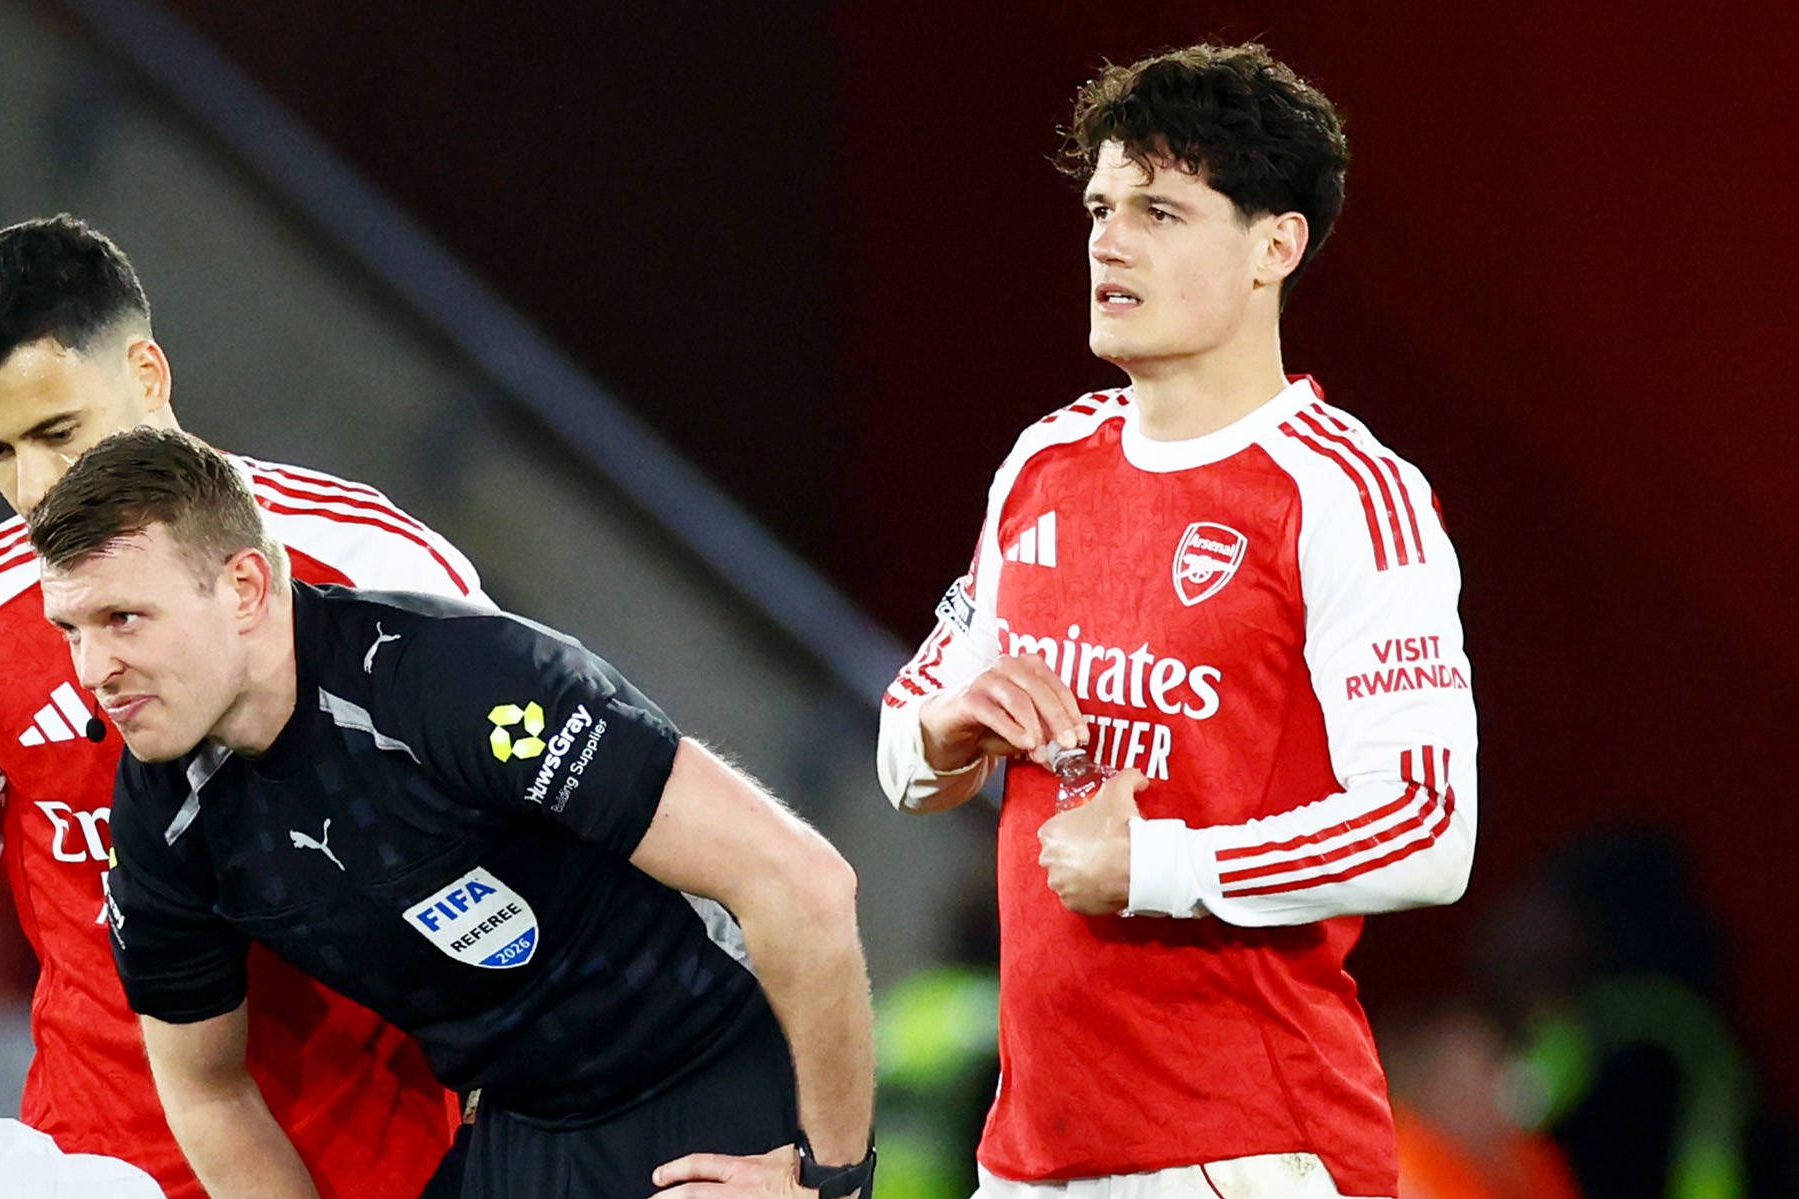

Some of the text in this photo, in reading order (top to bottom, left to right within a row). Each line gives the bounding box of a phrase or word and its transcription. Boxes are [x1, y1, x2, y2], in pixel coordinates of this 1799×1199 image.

[1188, 533, 1237, 558] Arsenal
[1371, 635, 1440, 664] VISIT
[1345, 664, 1469, 701] RWANDA
[523, 704, 593, 805] HuwsGray
[569, 718, 608, 776] Supplies
[415, 880, 498, 933] FIFA
[449, 902, 523, 953] REFEREE
